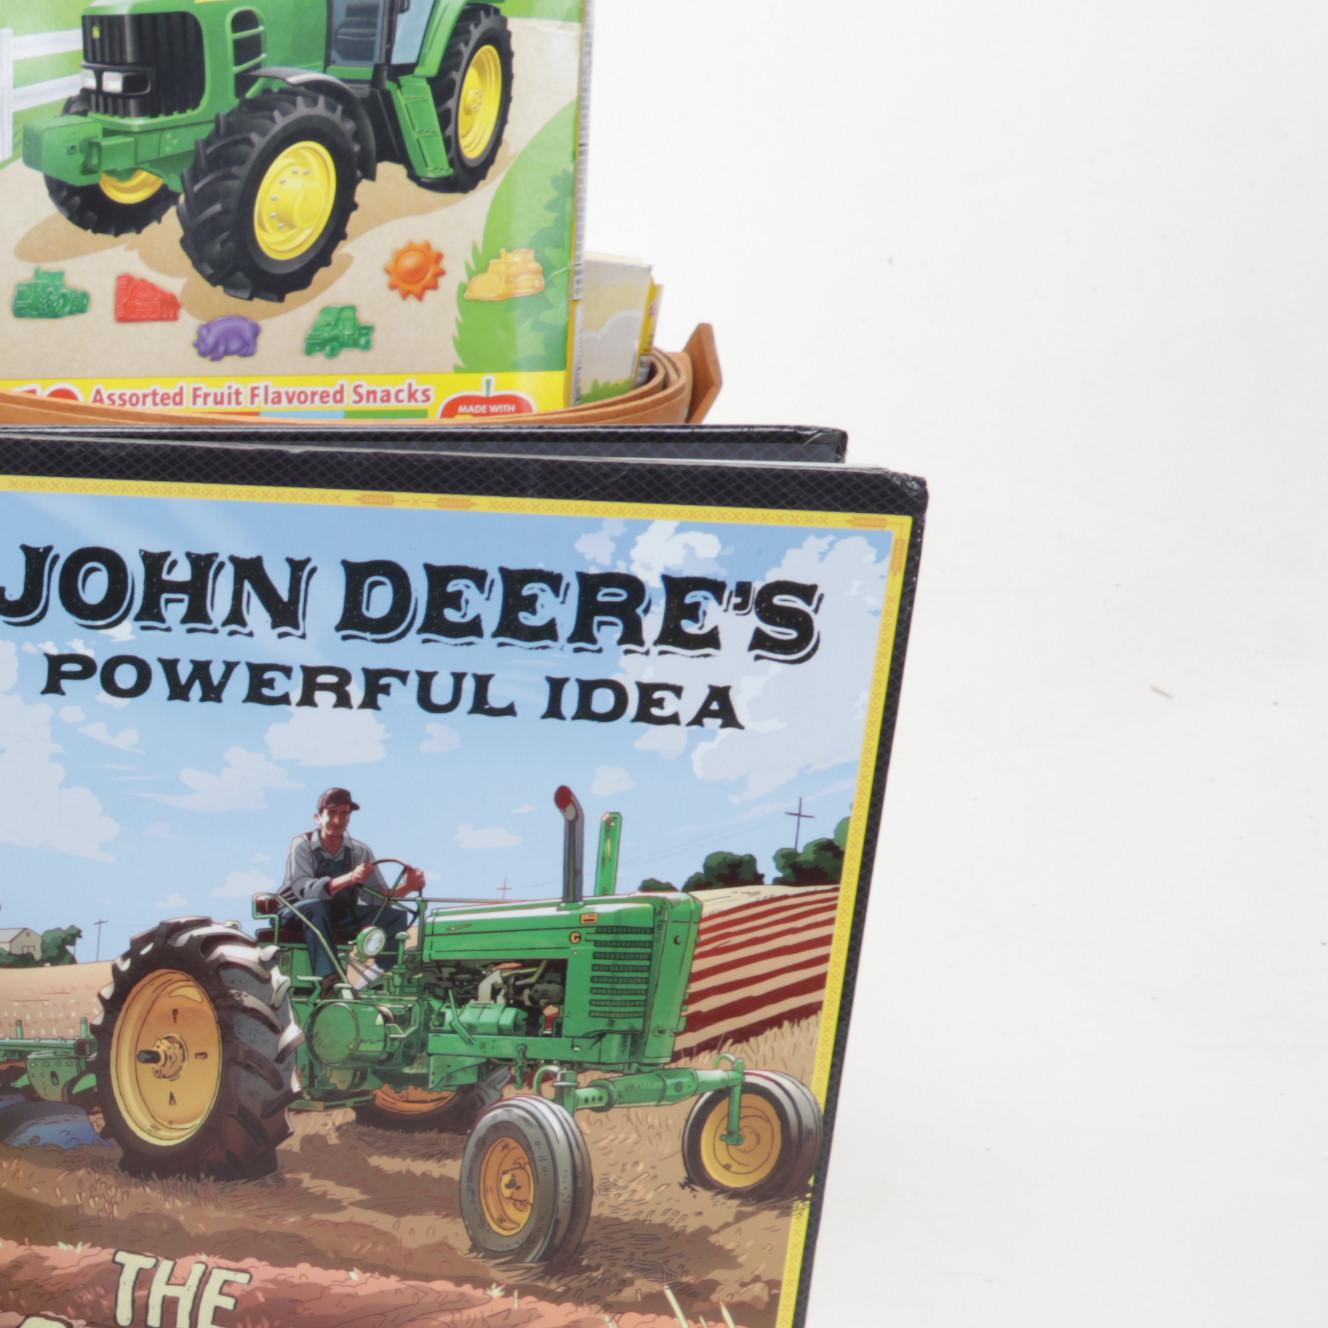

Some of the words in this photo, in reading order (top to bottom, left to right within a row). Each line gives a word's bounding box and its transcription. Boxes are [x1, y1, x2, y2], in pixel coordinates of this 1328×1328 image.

[92, 382, 185, 407] Assorted
[191, 384, 243, 406] Fruit
[249, 383, 345, 406] Flavored
[352, 382, 432, 405] Snacks
[458, 404, 488, 413] MADE
[489, 404, 516, 413] WITH
[334, 558, 822, 664] DEERE'S
[40, 652, 518, 719] POWERFUL
[540, 676, 745, 730] IDEA
